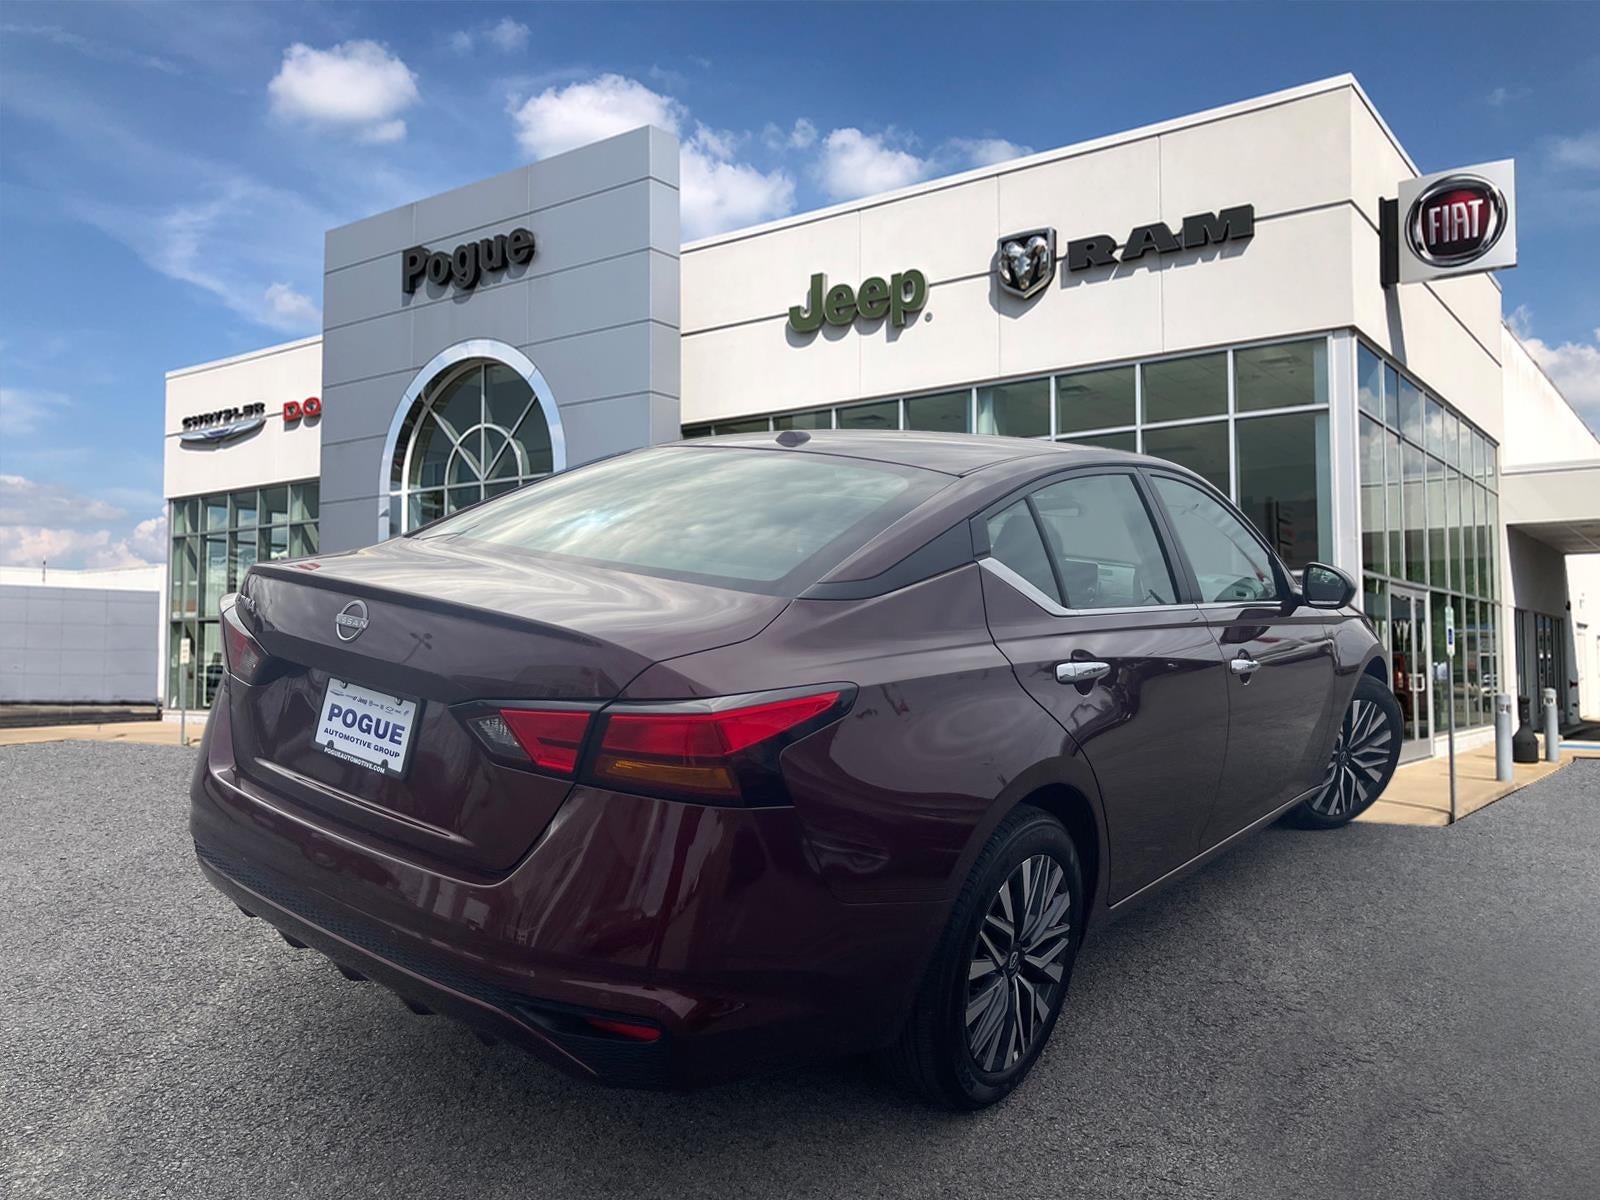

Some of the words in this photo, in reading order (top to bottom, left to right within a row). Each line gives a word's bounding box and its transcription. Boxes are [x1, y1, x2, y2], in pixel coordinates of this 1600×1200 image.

[1066, 203, 1254, 272] RAM
[1429, 199, 1484, 246] FIAT
[402, 227, 536, 294] Pogue
[789, 268, 926, 330] Jeep
[182, 402, 266, 429] CHRYSLER
[323, 727, 372, 750] AUTOMOTIVE
[373, 743, 401, 759] GROUP
[327, 703, 406, 746] POGUE
